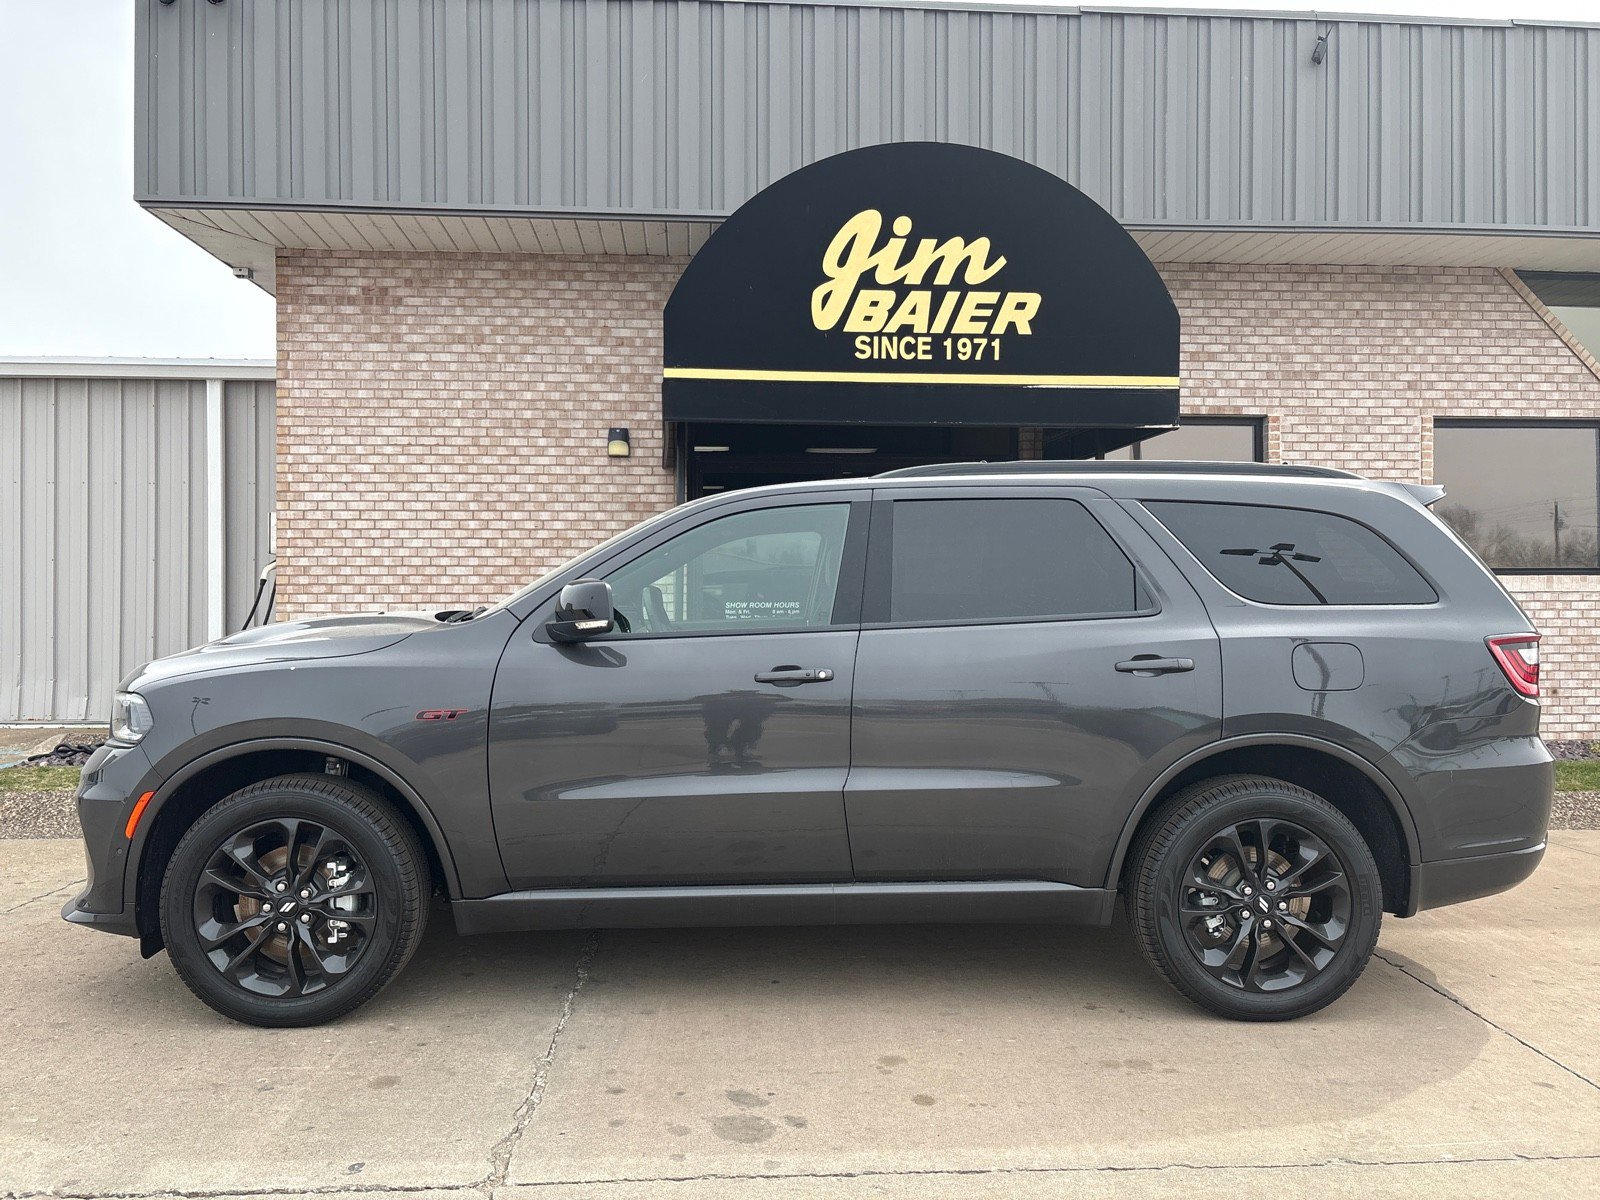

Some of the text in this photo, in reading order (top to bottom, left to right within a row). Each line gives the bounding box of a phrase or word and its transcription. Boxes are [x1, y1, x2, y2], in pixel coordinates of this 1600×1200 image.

[811, 209, 1007, 331] Jim
[843, 290, 1042, 335] BAIER
[854, 335, 1001, 361] SINCE 1971
[415, 709, 469, 720] GT
